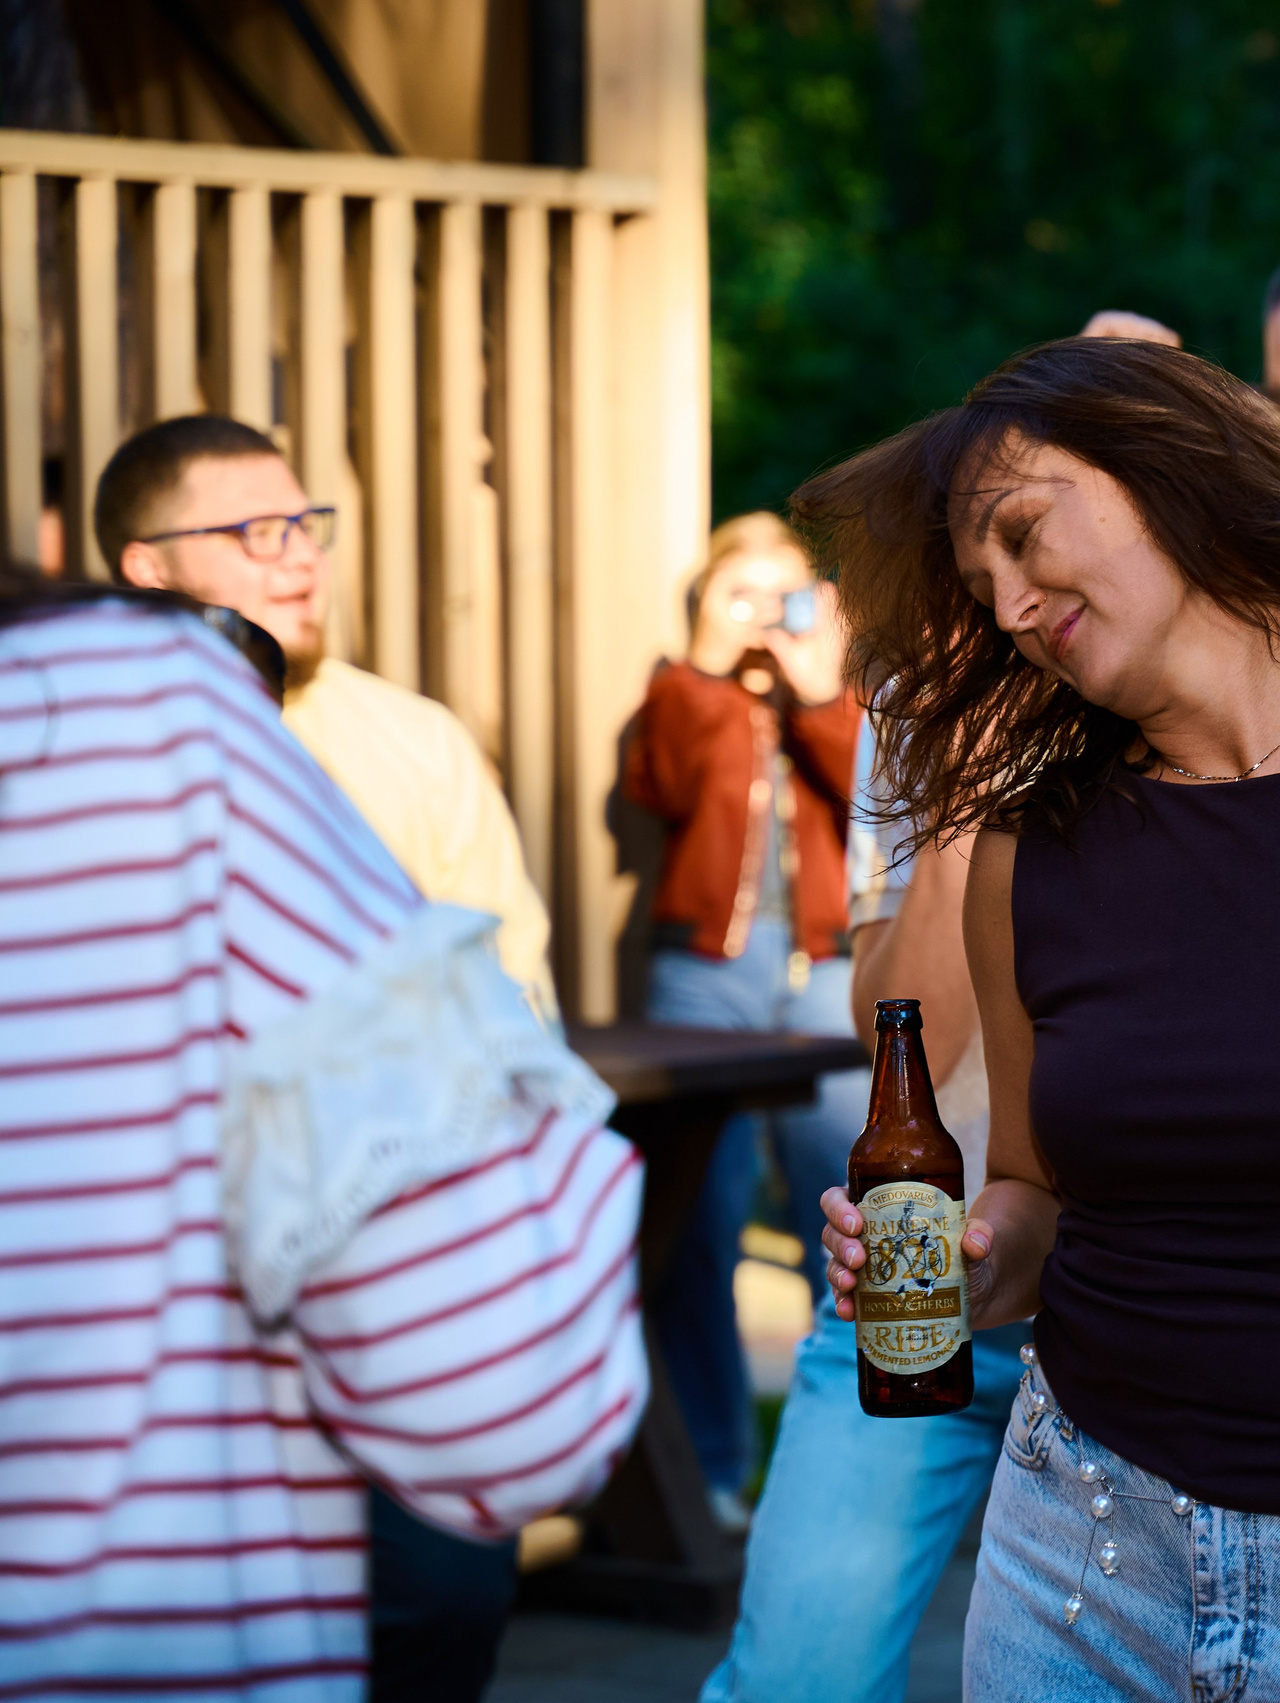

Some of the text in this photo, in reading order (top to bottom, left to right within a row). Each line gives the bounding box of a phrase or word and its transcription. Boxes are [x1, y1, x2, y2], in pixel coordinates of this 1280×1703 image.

[872, 1190, 934, 1206] MEDOVARUS
[863, 1235, 951, 1281] 1820
[864, 1297, 955, 1312] HONEY & HERBS
[874, 1322, 946, 1353] RIDE
[913, 1338, 956, 1365] LEMONADE
